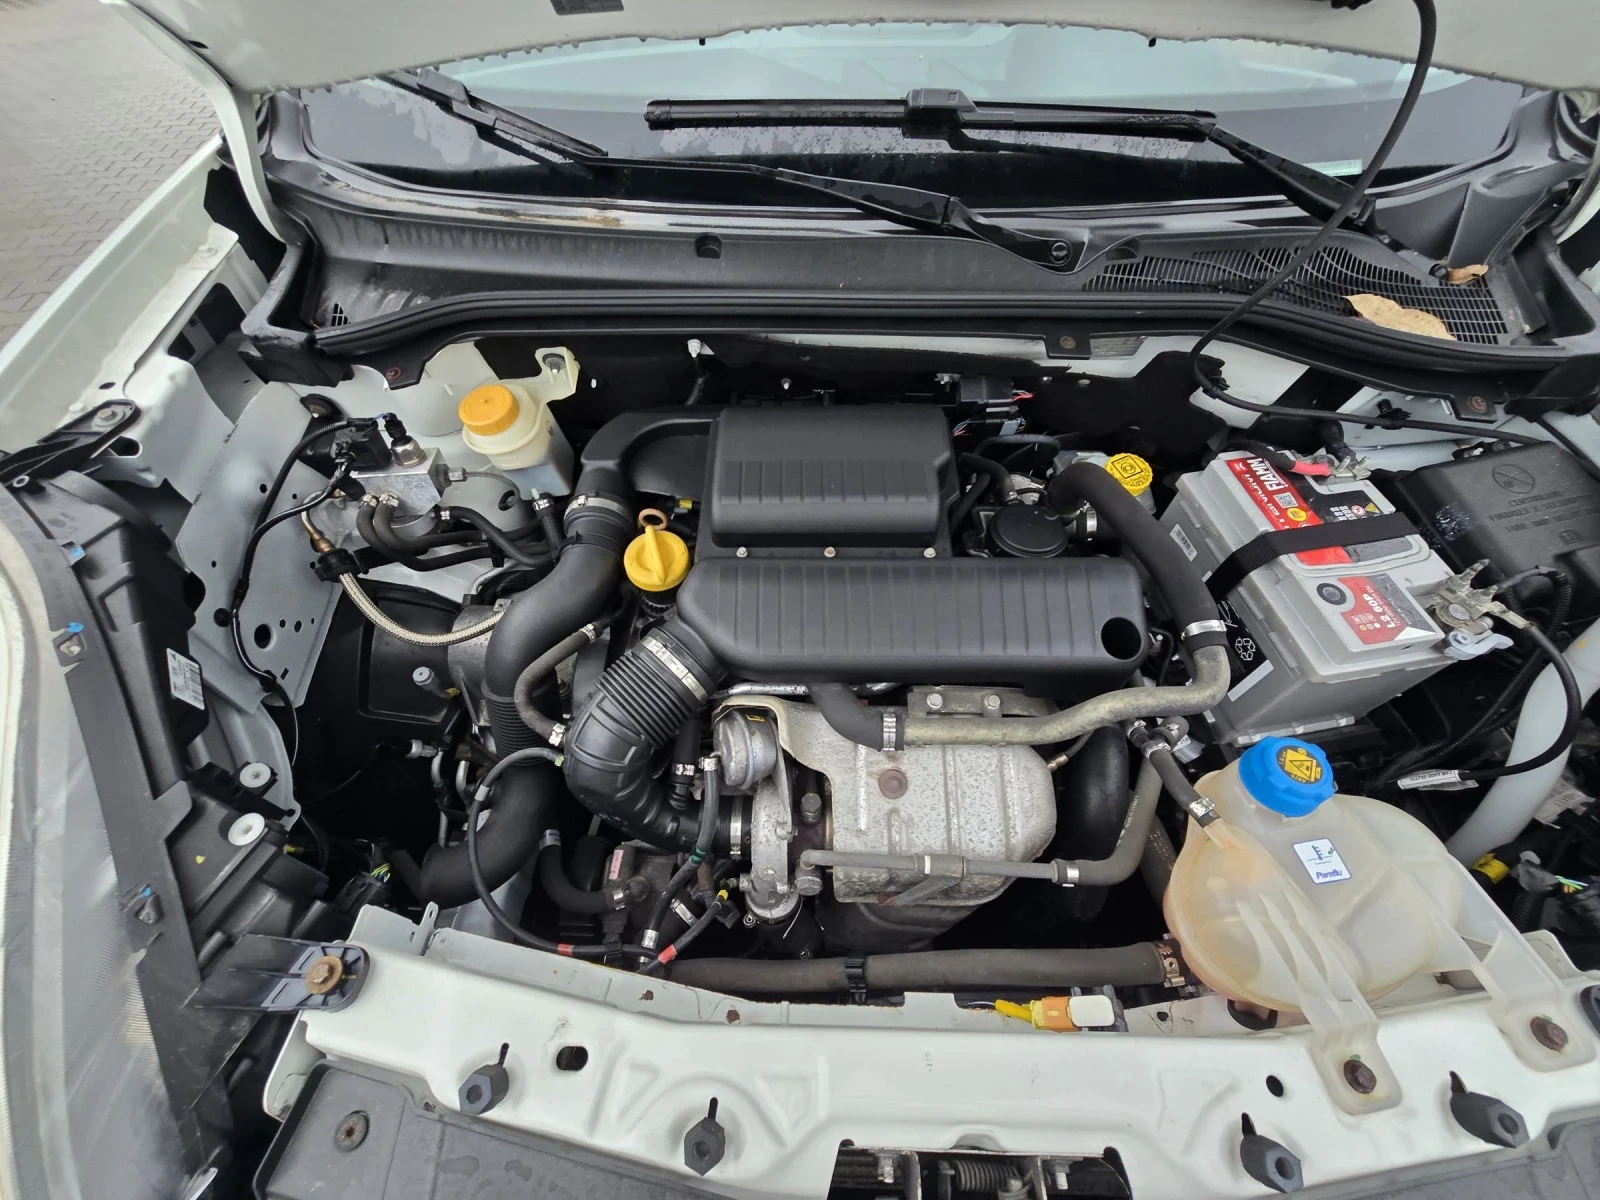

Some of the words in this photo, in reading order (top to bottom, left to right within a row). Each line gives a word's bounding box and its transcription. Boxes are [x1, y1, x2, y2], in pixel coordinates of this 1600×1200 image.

[1246, 458, 1285, 491] FIAMM
[1362, 593, 1383, 613] 60P
[1380, 614, 1397, 629] L2
[1315, 868, 1343, 880] Paraflu
